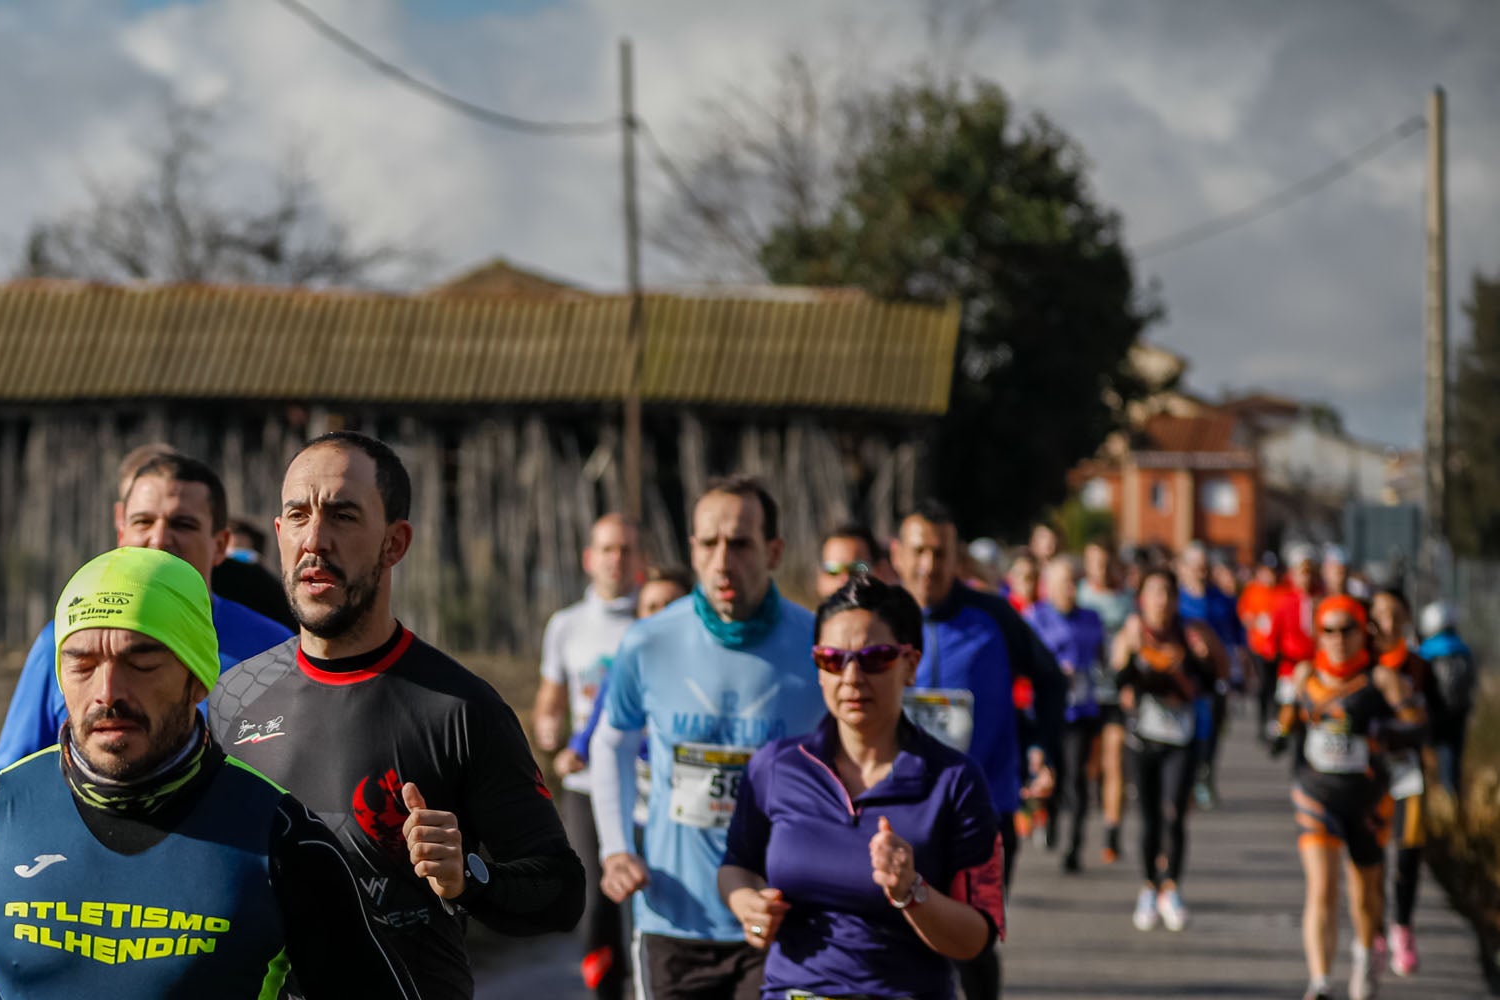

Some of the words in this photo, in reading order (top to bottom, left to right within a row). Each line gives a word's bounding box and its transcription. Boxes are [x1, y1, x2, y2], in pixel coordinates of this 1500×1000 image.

[81, 607, 123, 615] olimpo
[102, 597, 125, 605] KIA
[4, 901, 231, 933] ATLETISMO
[14, 923, 216, 965] ALHENDÍN
